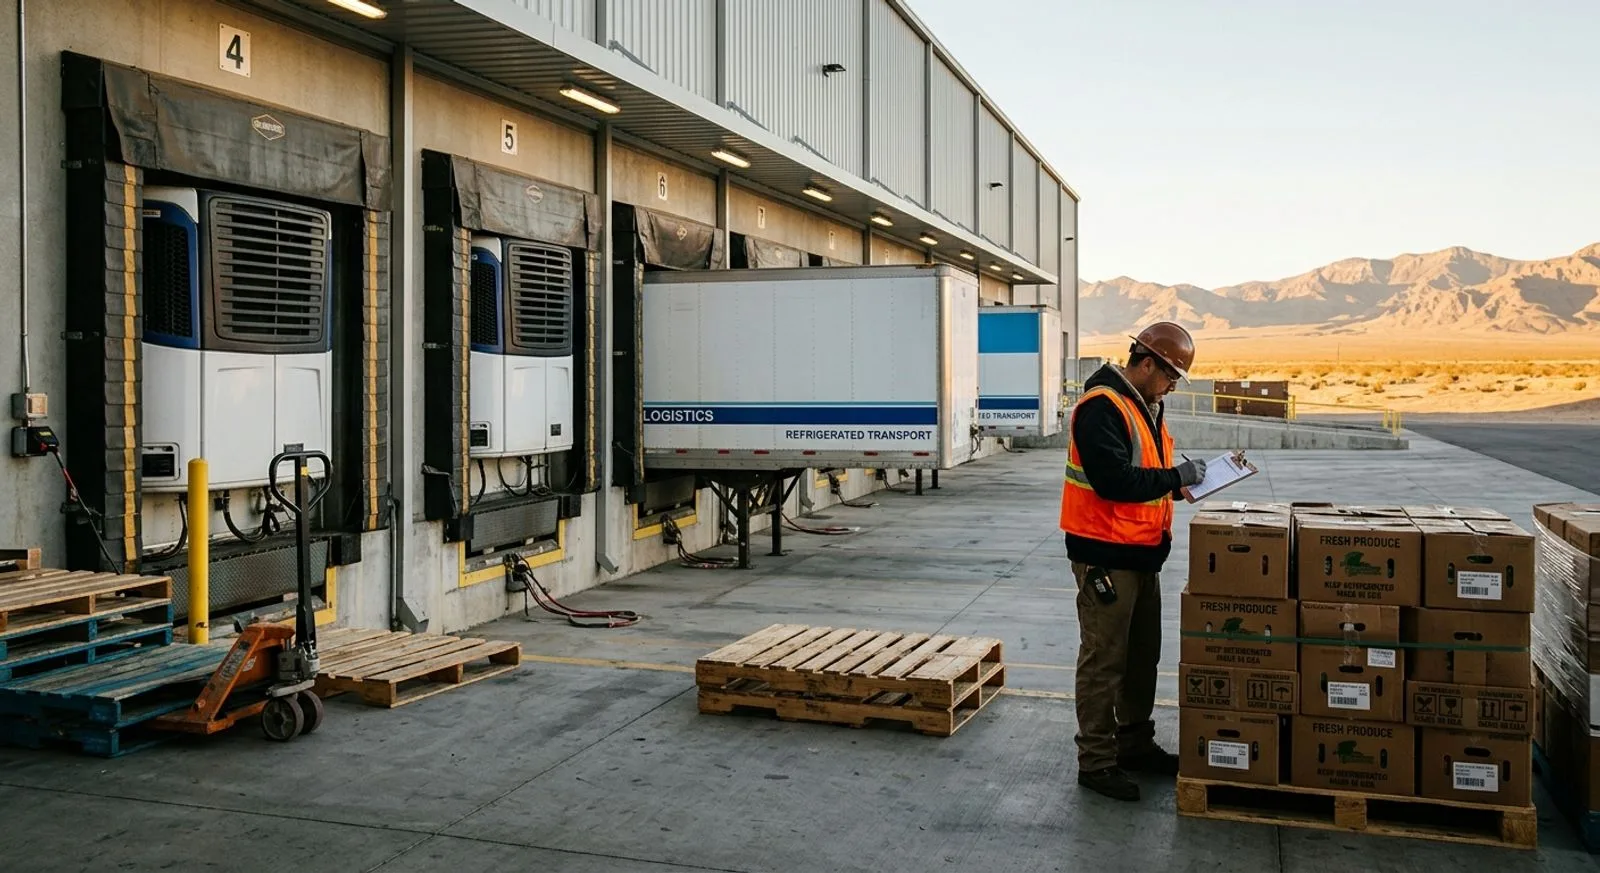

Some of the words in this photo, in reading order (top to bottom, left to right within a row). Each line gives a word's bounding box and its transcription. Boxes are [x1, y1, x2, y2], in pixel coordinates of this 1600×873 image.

[226, 34, 243, 69] 4
[505, 124, 514, 150] 5
[660, 175, 666, 197] 6
[643, 410, 714, 422] LOGISTICS
[993, 412, 1036, 420] TRANSPORT
[786, 430, 865, 440] REFRIGERATED
[868, 430, 932, 440] TRANSPORT
[1320, 535, 1350, 546] FRESH
[1353, 536, 1400, 549] PRODUCE
[1201, 602, 1231, 612] FRESH
[1233, 603, 1278, 615] PRODUCE
[1313, 722, 1344, 735] FRESH
[1346, 724, 1394, 738] PRODUCE
